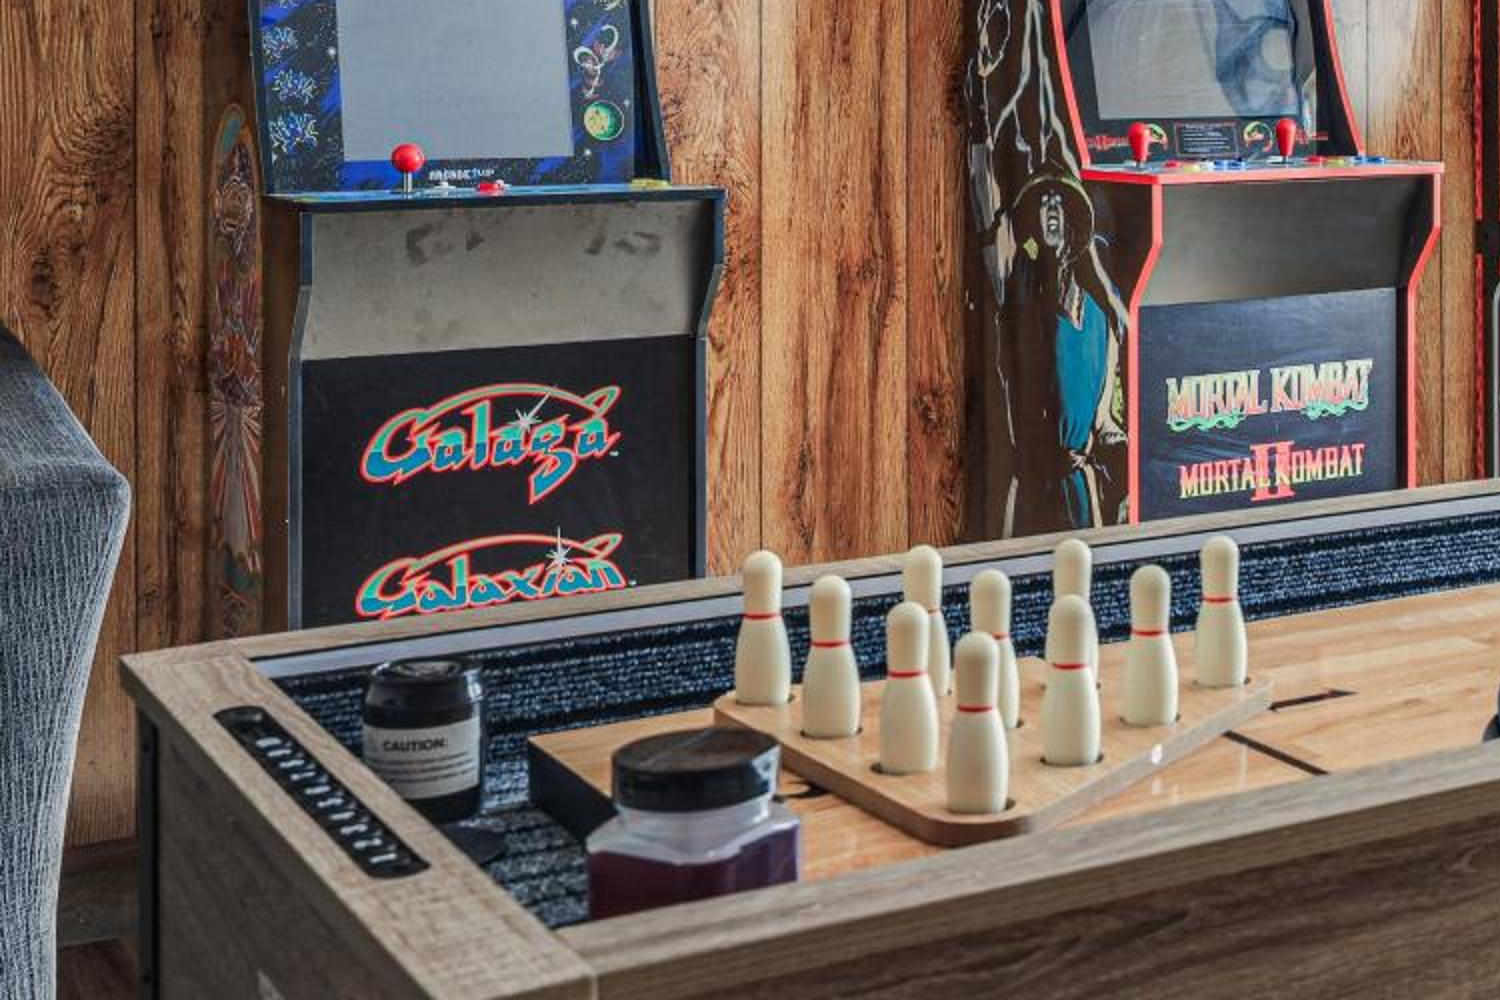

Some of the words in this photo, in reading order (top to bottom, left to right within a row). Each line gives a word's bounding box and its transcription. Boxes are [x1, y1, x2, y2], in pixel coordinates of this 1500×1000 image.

[1166, 369, 1268, 424] MORTAL
[1270, 358, 1375, 412] KOMBAT
[359, 382, 621, 504] Galaga
[1179, 455, 1271, 499] MORTAL
[1275, 443, 1365, 487] KOMBAT
[355, 532, 627, 620] Galaxian
